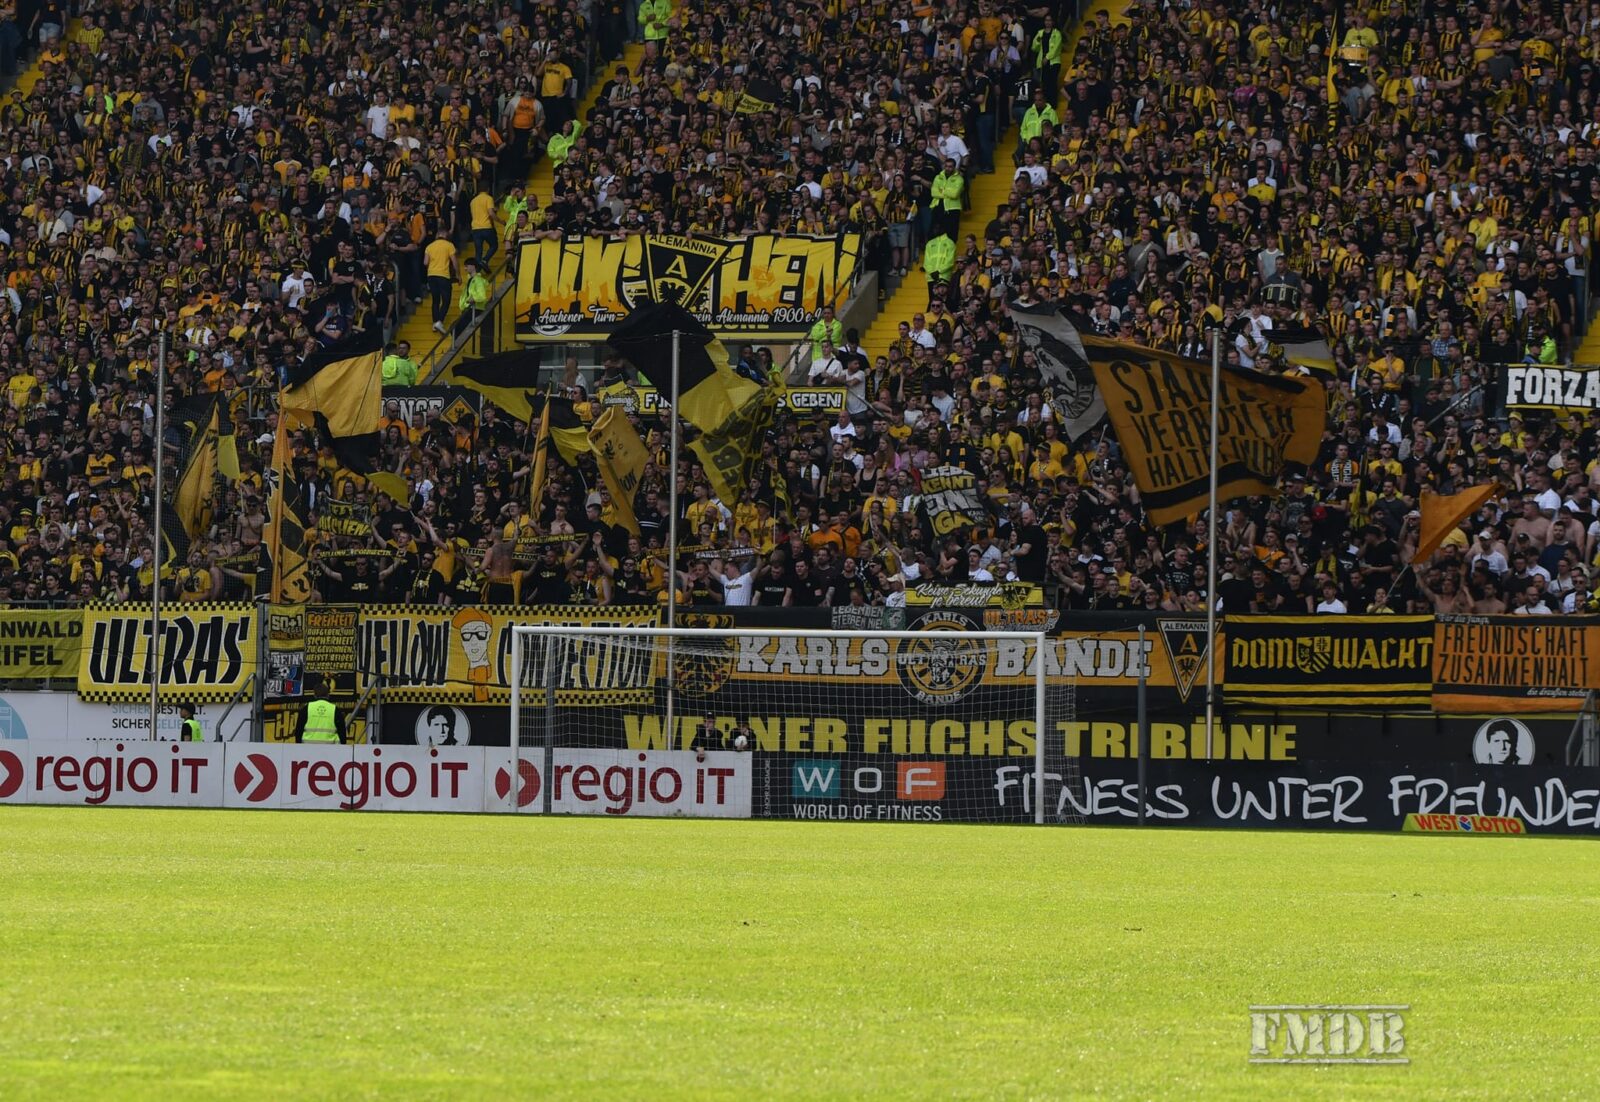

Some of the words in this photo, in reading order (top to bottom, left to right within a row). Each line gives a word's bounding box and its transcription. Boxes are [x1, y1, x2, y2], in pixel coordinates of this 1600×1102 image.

[649, 233, 718, 258] ALEMANNIA
[665, 254, 688, 278] A
[539, 309, 584, 324] Aachener
[588, 305, 625, 325] Turn-
[716, 308, 770, 325] Alemannia
[773, 307, 804, 323] 1900
[1506, 367, 1600, 408] FORZA
[791, 393, 842, 408] GEBEN!
[954, 583, 1003, 597] Sekunde
[307, 613, 355, 627] FREIHEIT
[921, 613, 968, 628] KARLS
[1164, 622, 1211, 631] ALEMANN
[88, 613, 251, 686] ULTRAS
[307, 636, 354, 645] SICHERHEIT
[1180, 634, 1198, 653] A
[1442, 624, 1588, 656] FREUNDSCHAFT
[0, 645, 63, 666] IFEL
[359, 619, 449, 688] YELLOW
[737, 635, 889, 677] KARLS
[993, 638, 1154, 678] BANDE
[1437, 653, 1589, 687] ZUSAMMENHALT
[915, 687, 965, 705] BANDE
[112, 704, 150, 714] SICHER
[112, 718, 151, 729] SICHER
[864, 719, 1036, 756] FUCHS
[1056, 716, 1298, 760] TRIBÜNE
[36, 744, 158, 804] regio
[290, 748, 417, 810] regio
[554, 753, 682, 815] regio
[994, 766, 1189, 819] FITNESS
[1211, 775, 1367, 823] UNTER
[1388, 775, 1600, 828] FREUNDE
[793, 804, 848, 819] WORLD
[853, 805, 873, 819] OF
[878, 805, 942, 821] FITNESS
[1414, 815, 1459, 831] WEST
[1472, 816, 1522, 834] LOTTO
